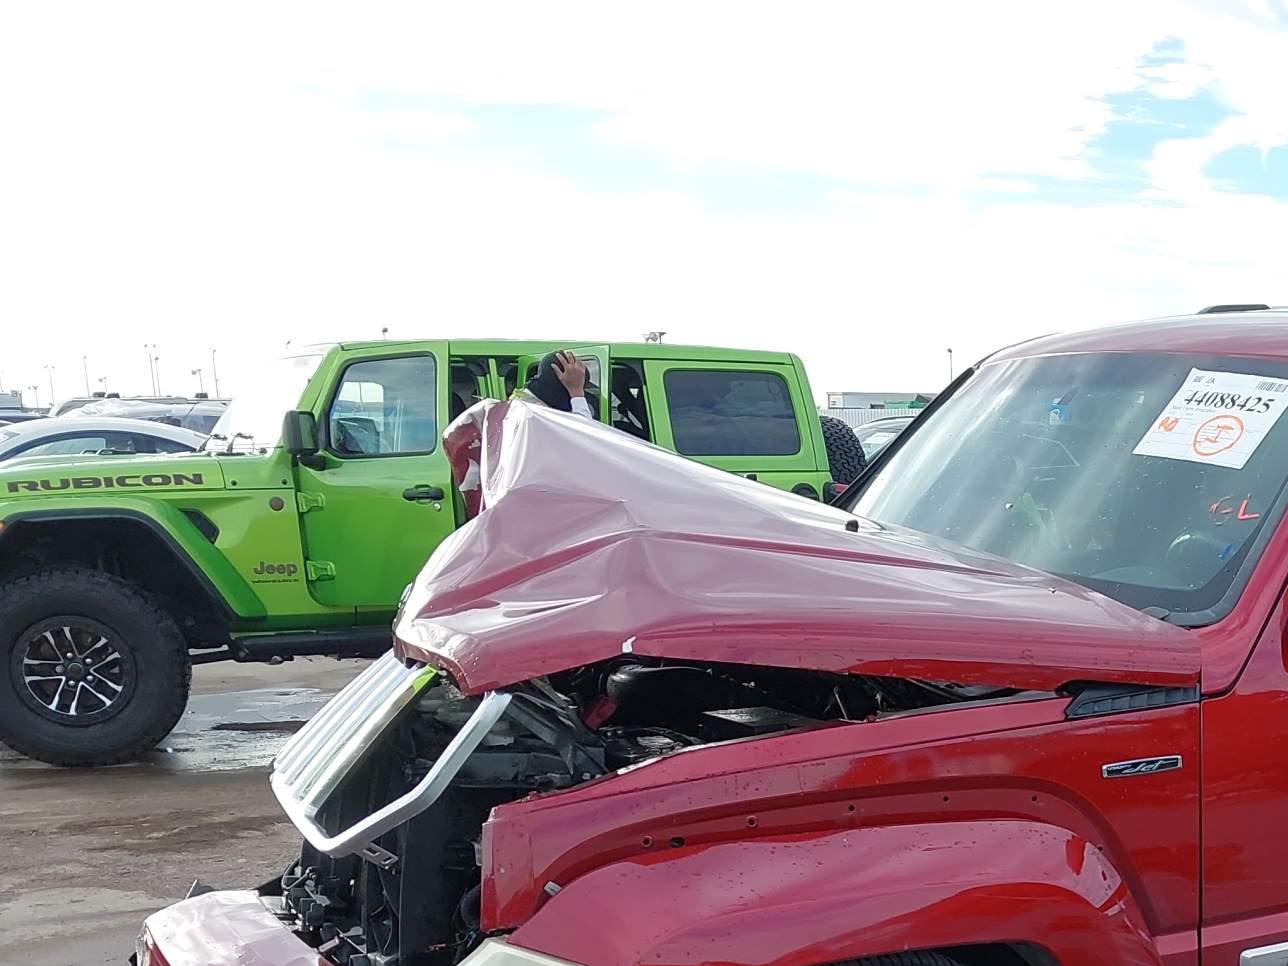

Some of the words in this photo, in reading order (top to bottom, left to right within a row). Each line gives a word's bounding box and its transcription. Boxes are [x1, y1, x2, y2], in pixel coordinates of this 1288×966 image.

[1184, 390, 1275, 414] 44088425
[7, 473, 204, 493] RUBICON
[253, 561, 298, 576] Jeep
